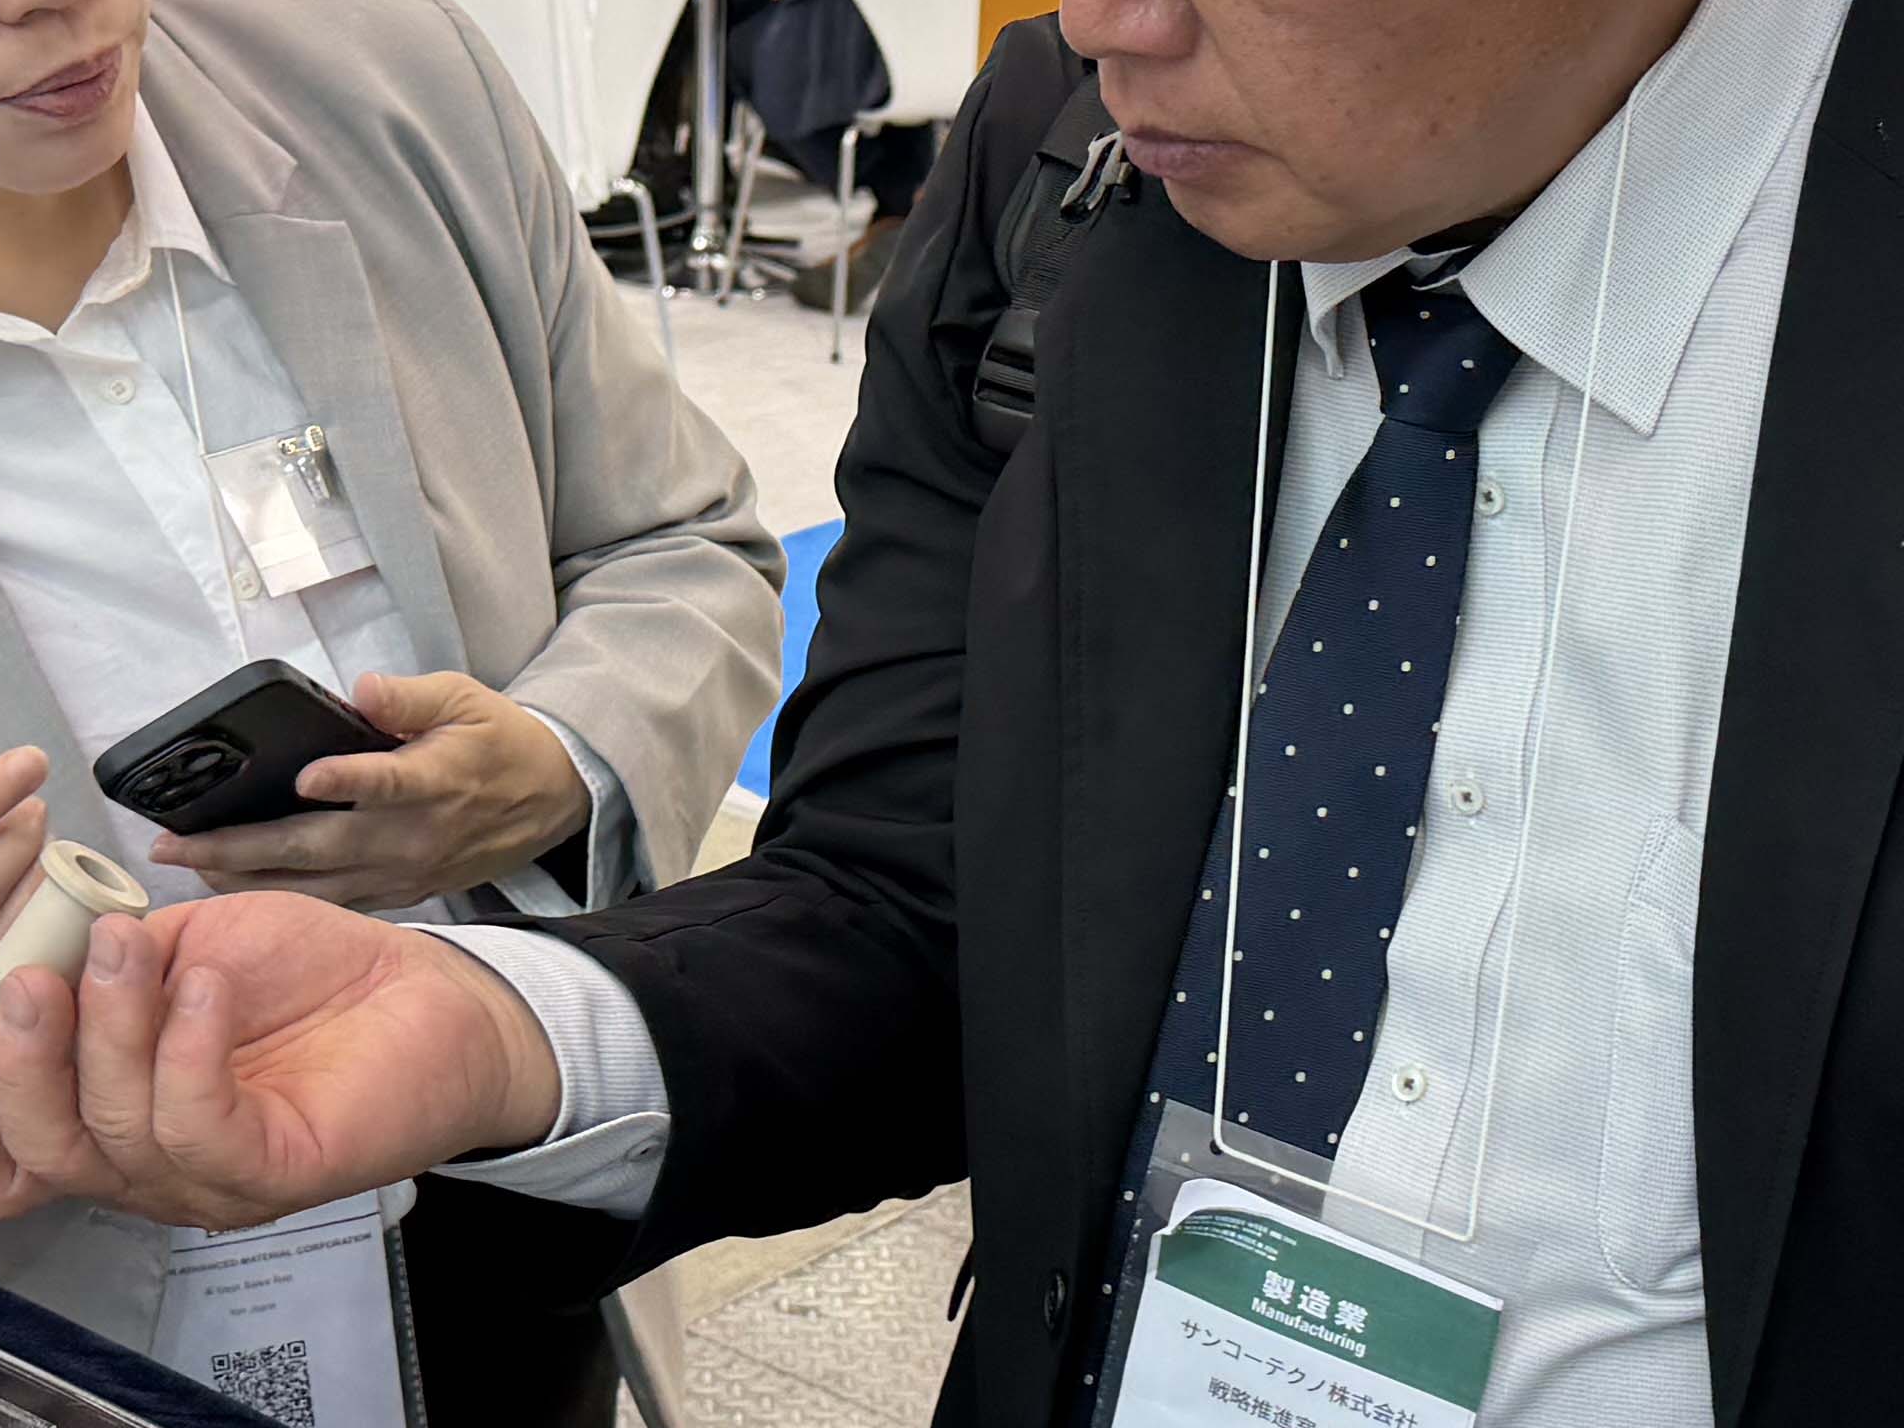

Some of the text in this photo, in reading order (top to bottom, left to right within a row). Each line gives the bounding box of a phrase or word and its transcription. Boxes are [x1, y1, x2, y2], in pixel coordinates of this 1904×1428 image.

[1244, 1296, 1367, 1359] Manufacturing
[1254, 1269, 1369, 1334] 製造業
